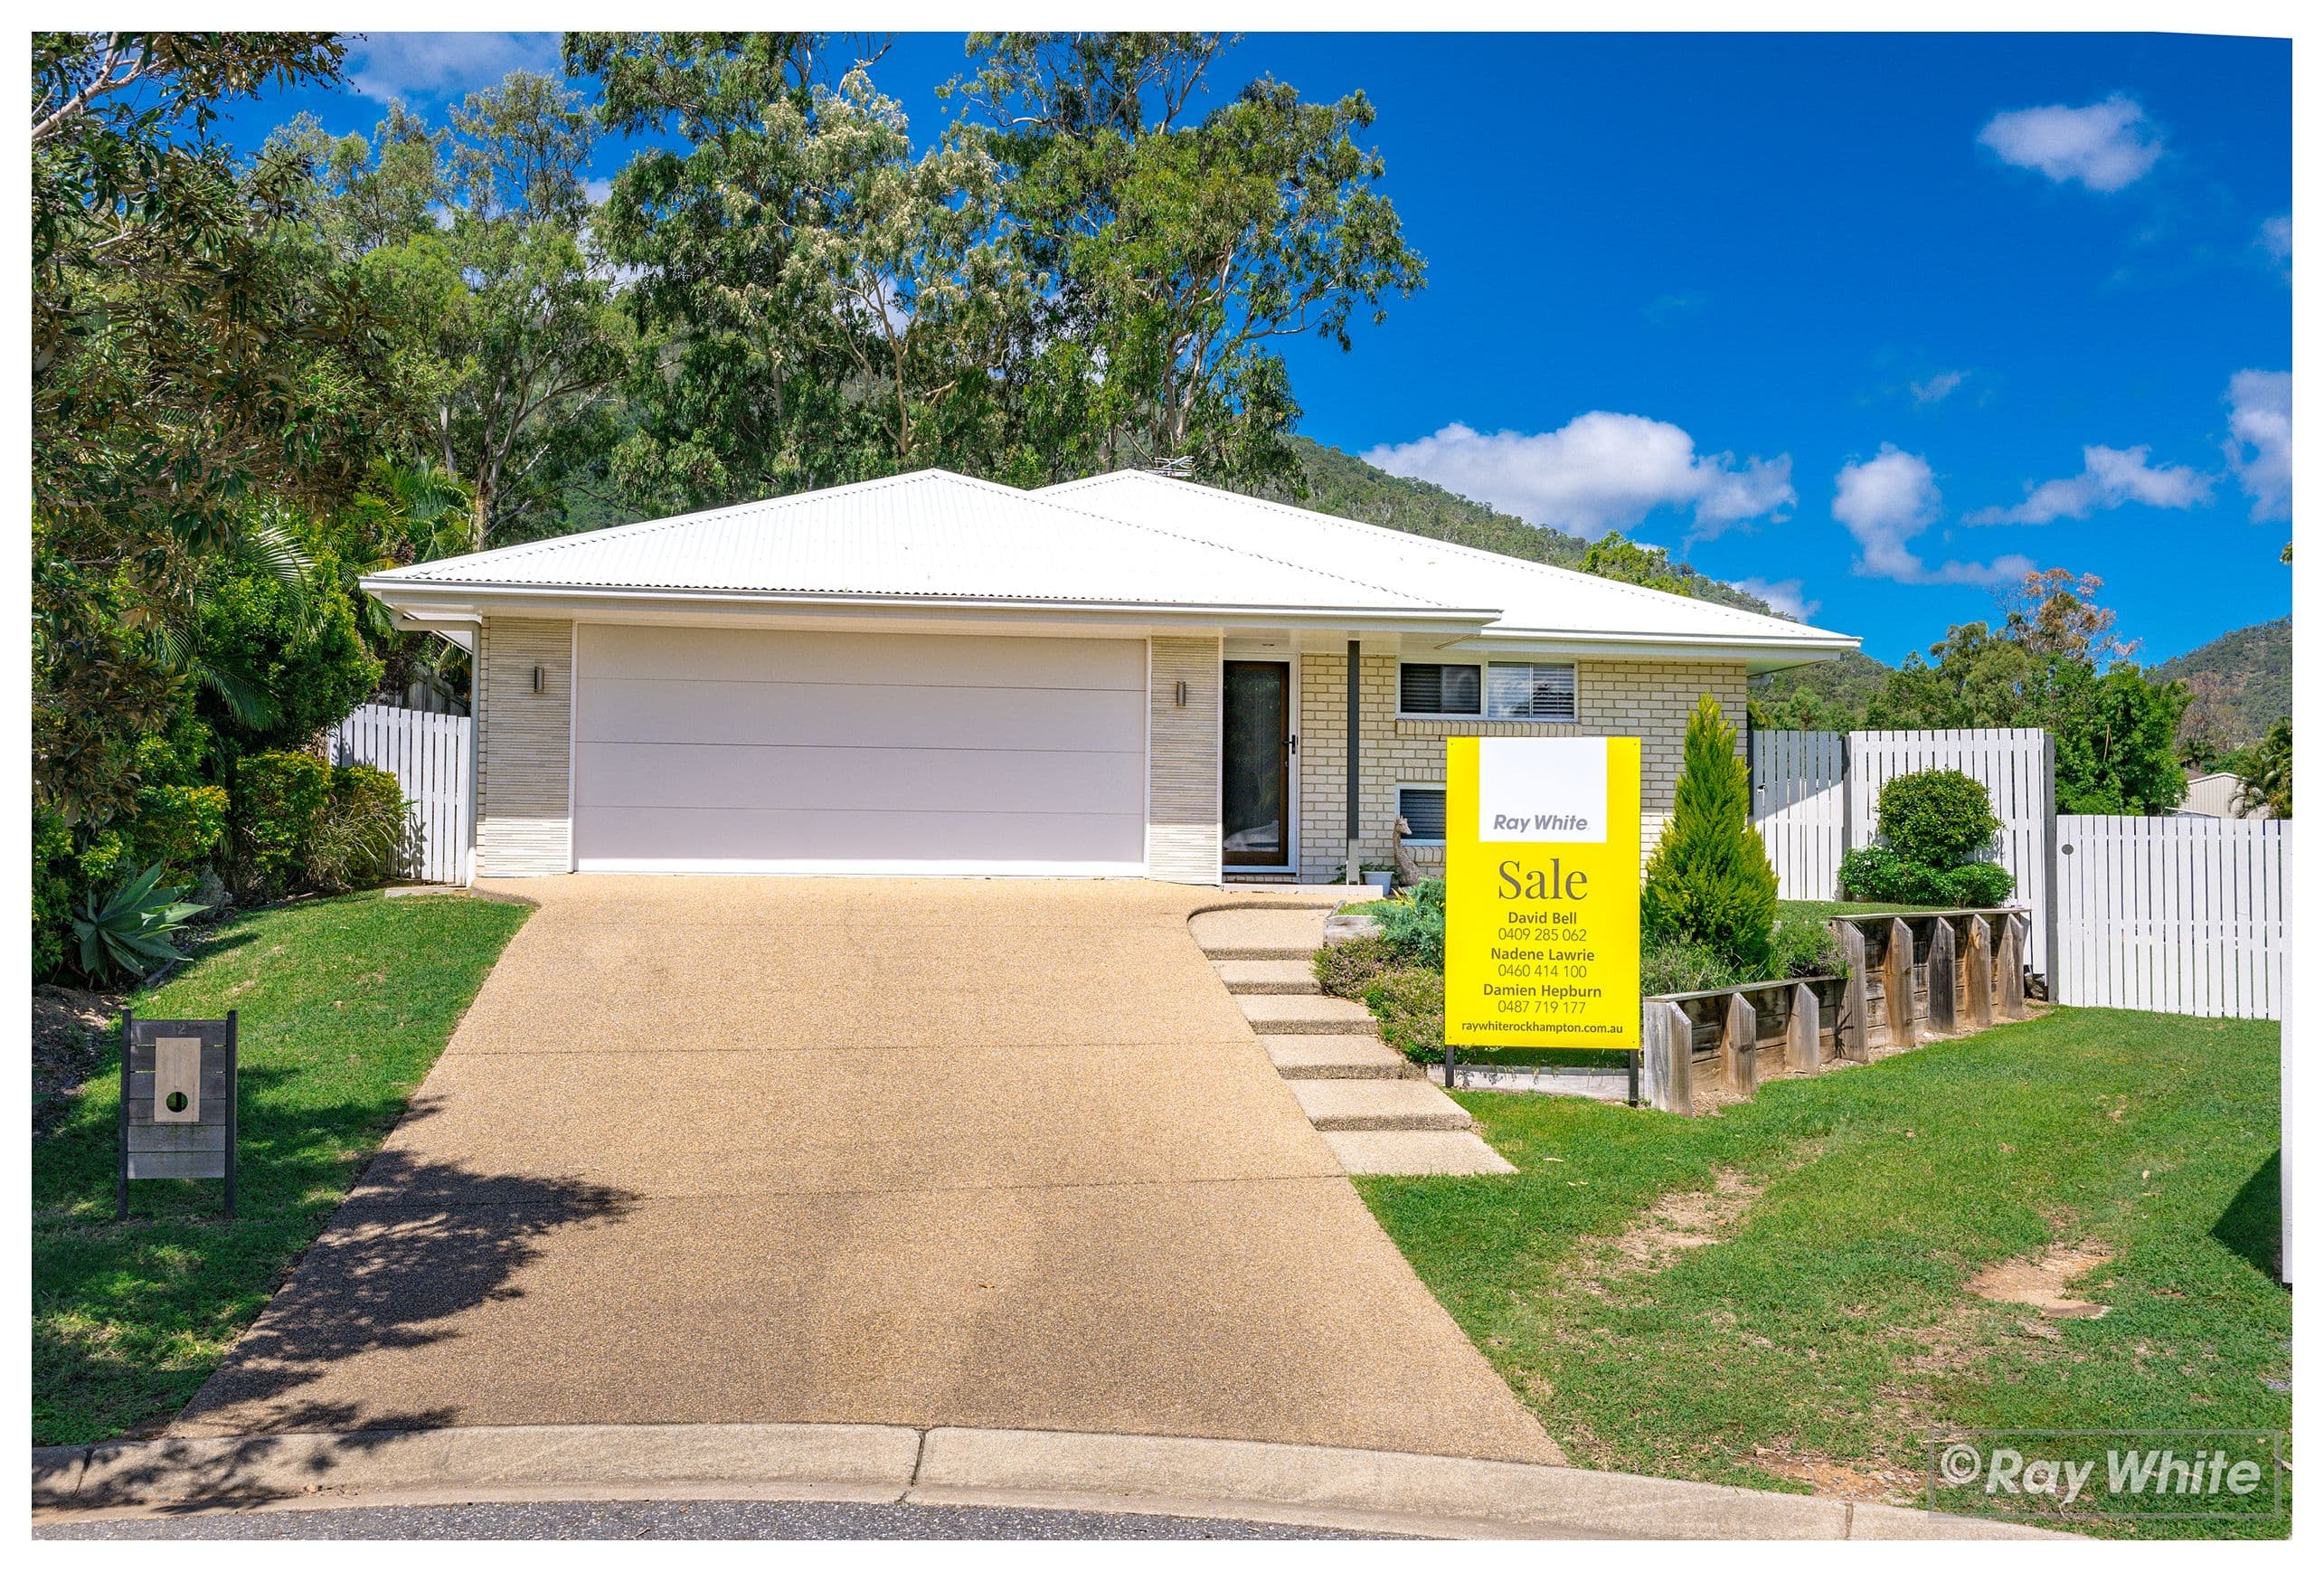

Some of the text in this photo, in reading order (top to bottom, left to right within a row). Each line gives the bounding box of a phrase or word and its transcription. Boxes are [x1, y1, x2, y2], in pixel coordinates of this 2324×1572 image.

[1493, 814, 1589, 833] Ray White
[1498, 858, 1588, 901] Sale
[1508, 911, 1578, 925] David Bell
[1497, 927, 1587, 942] 0409 285 062
[1490, 947, 1595, 961] Nadene Lawrie
[1497, 963, 1587, 979] 0460 414 100
[1483, 983, 1602, 1000] Damien Hepburn
[1497, 999, 1586, 1014] 0487 719 177
[1461, 1020, 1623, 1035] raywhiterockhampton.com.au
